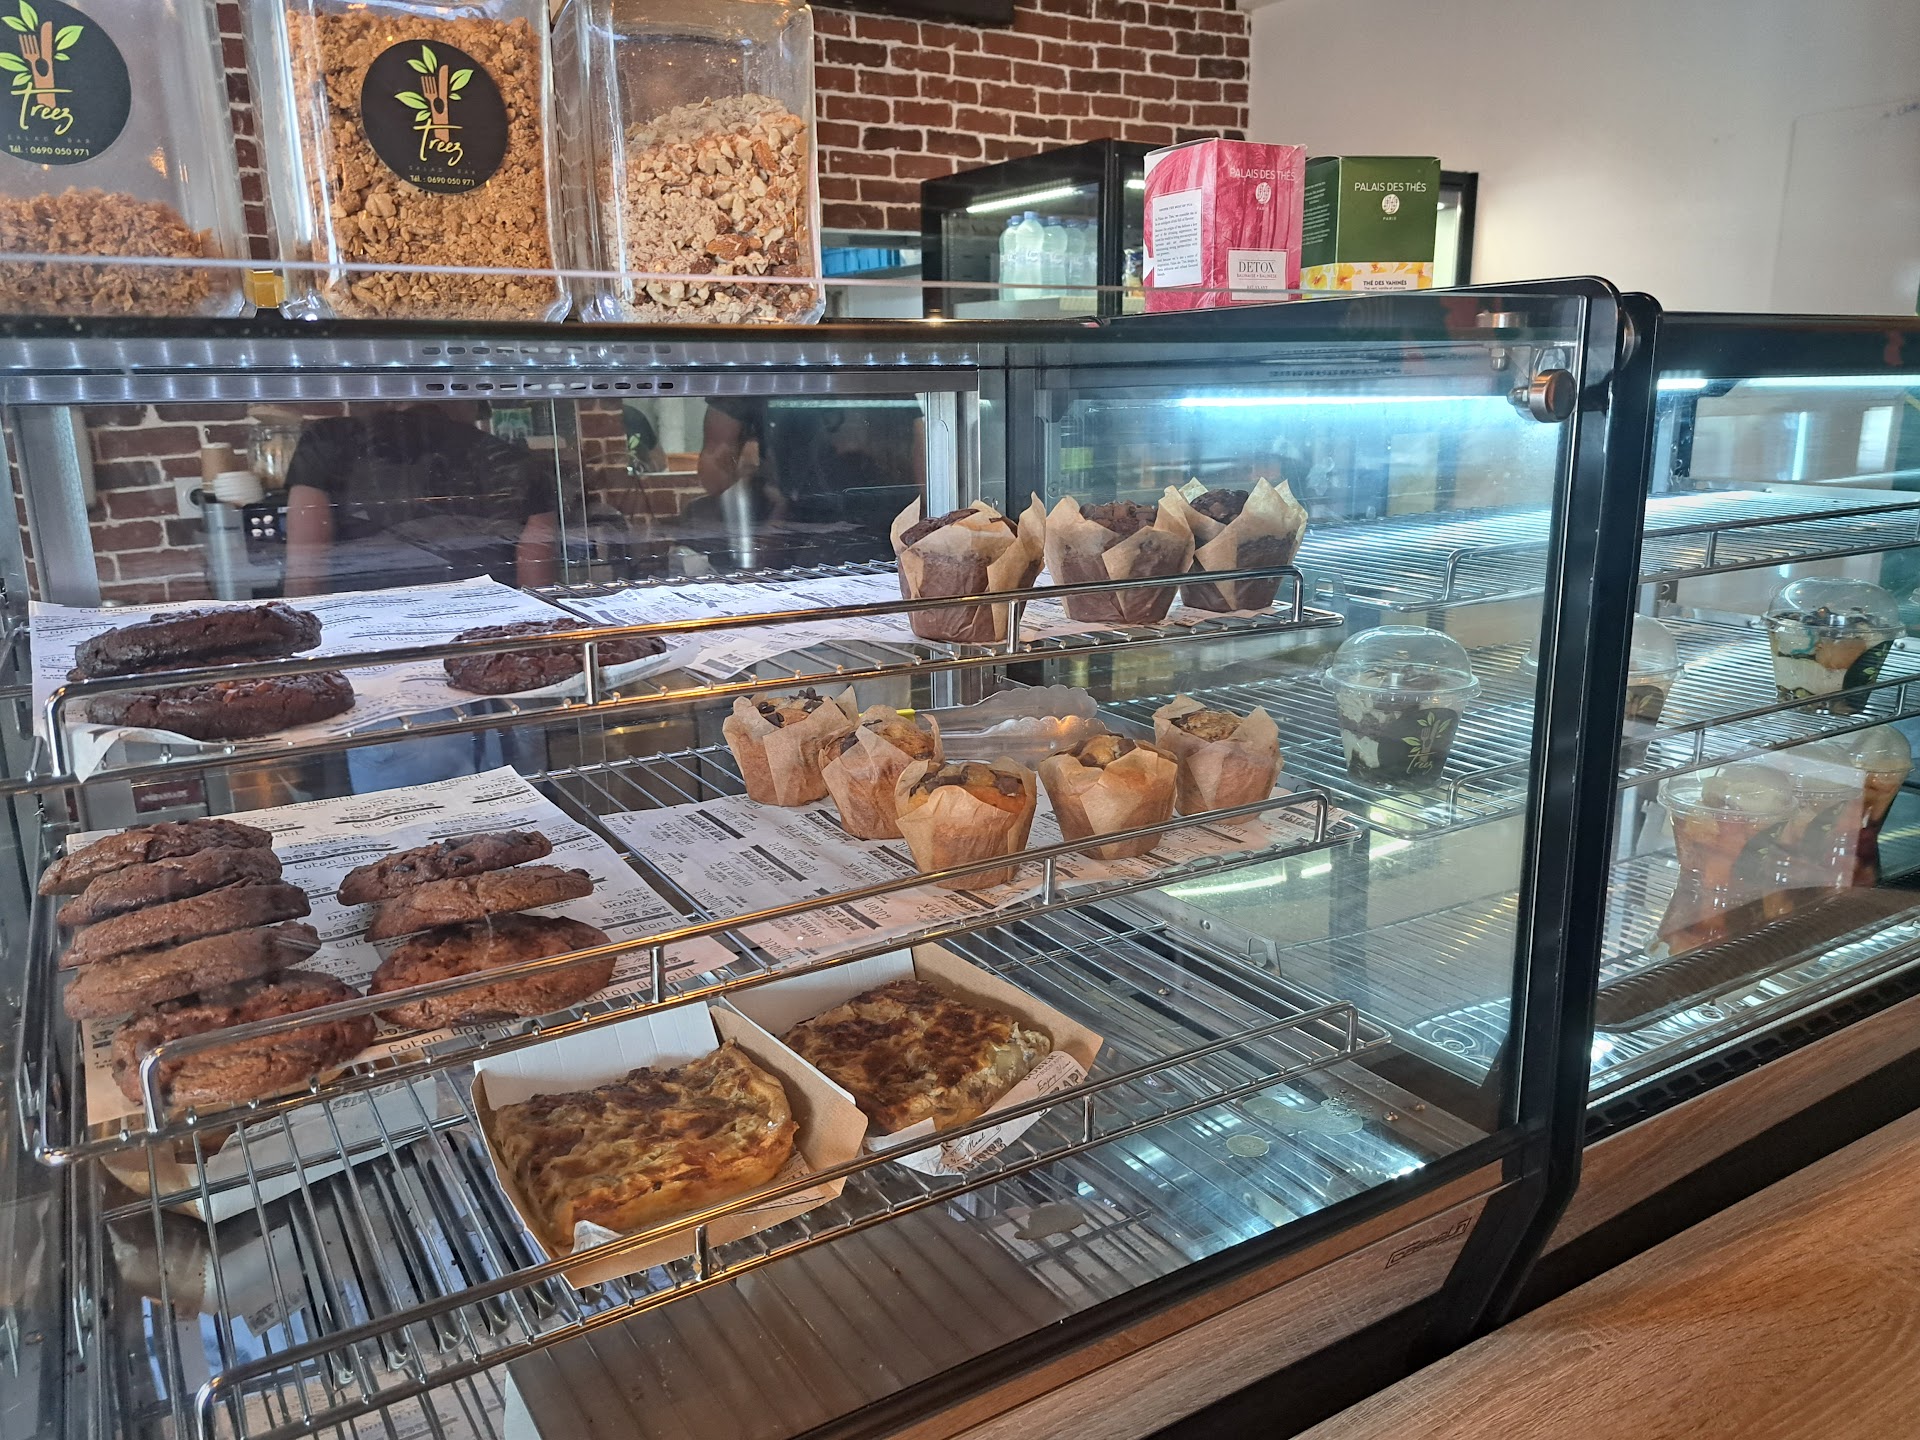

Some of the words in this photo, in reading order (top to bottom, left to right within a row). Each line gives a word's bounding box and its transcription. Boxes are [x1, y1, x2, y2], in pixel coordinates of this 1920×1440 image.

[30, 146, 53, 155] 0690
[54, 147, 72, 156] 050
[73, 148, 90, 157] 971
[1229, 167, 1259, 179] PALAIS
[1259, 169, 1276, 180] DES
[427, 176, 446, 184] 0690
[447, 177, 461, 185] 050
[462, 178, 476, 186] 971
[1354, 182, 1385, 192] PALAIS
[1386, 182, 1404, 192] DES
[1405, 181, 1427, 193] THÉS
[1238, 261, 1275, 273] DETOX
